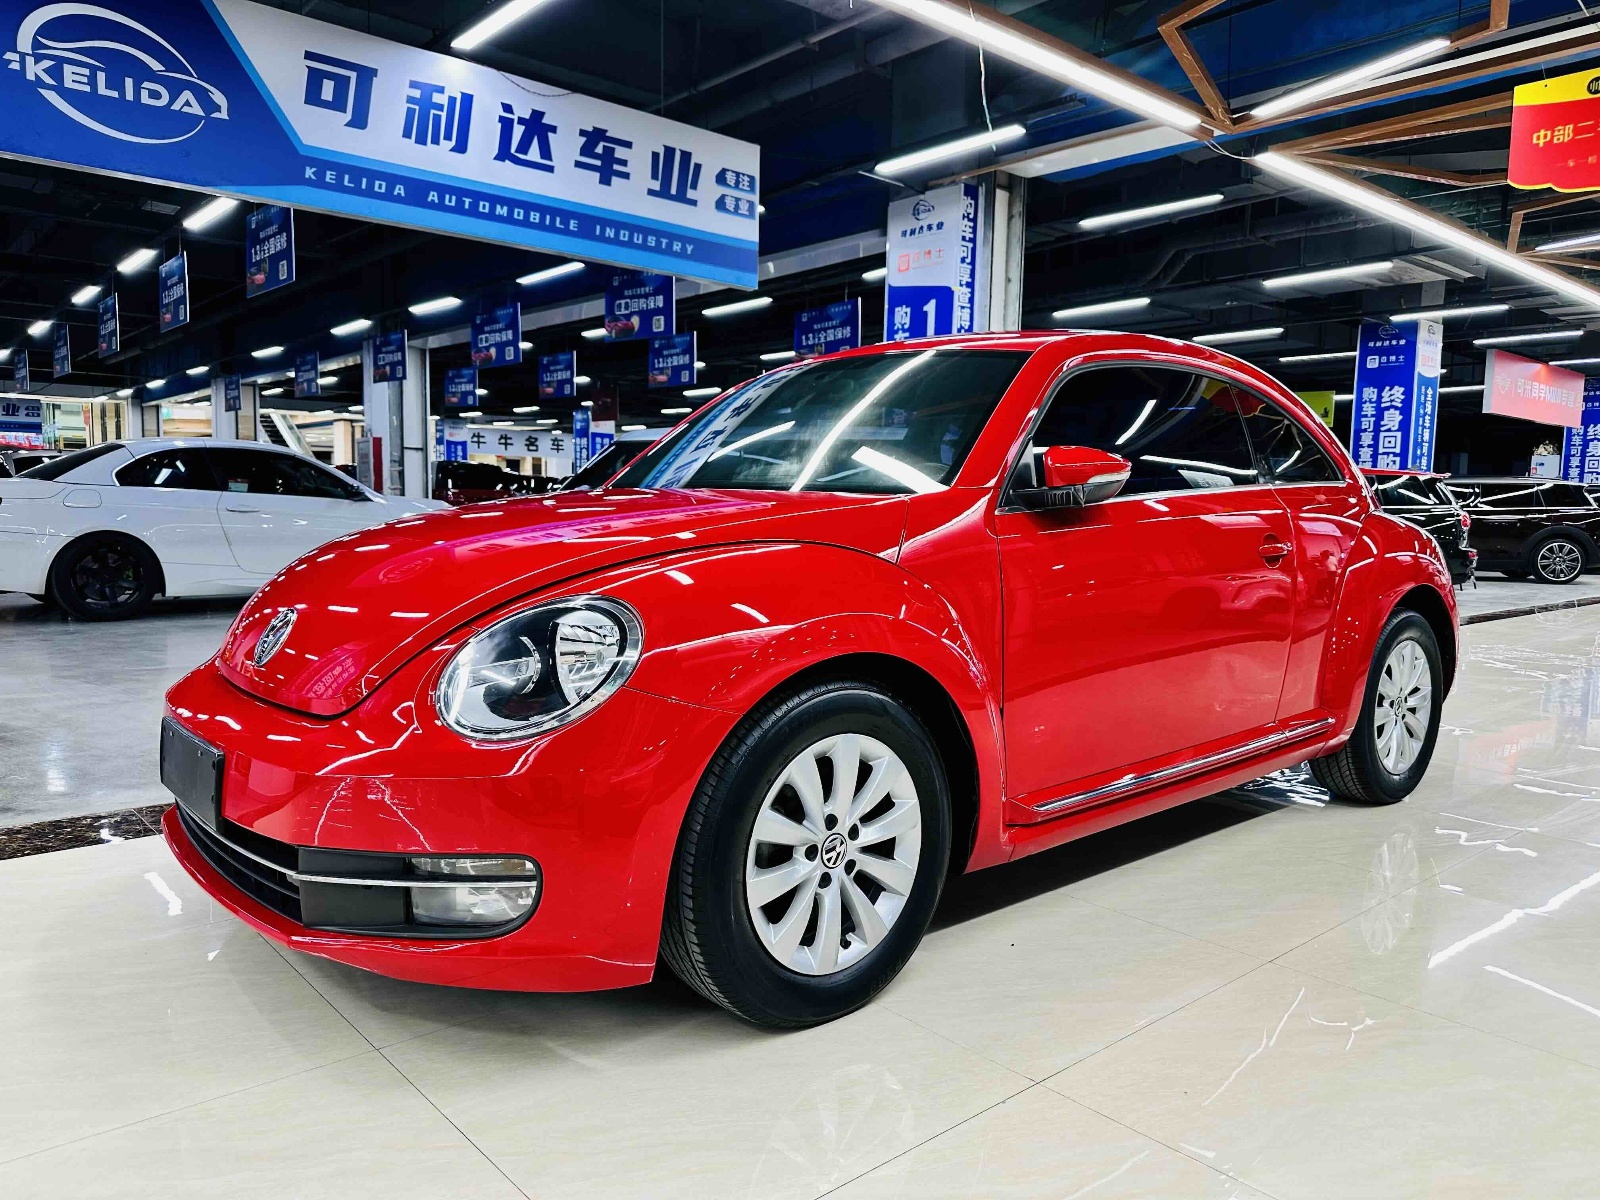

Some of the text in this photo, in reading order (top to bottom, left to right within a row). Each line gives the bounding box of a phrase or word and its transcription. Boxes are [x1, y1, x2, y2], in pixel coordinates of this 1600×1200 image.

[24, 57, 206, 117] KELIDA
[303, 49, 702, 207] 可利达车业
[1533, 121, 1600, 147] 中部二
[724, 169, 751, 191] 专注
[304, 166, 695, 255] KELIDA AUTOMOBILE INDUSTRY
[723, 195, 750, 216] 专业
[470, 431, 565, 454] 牛牛名车
[1377, 386, 1405, 470] 终身回购
